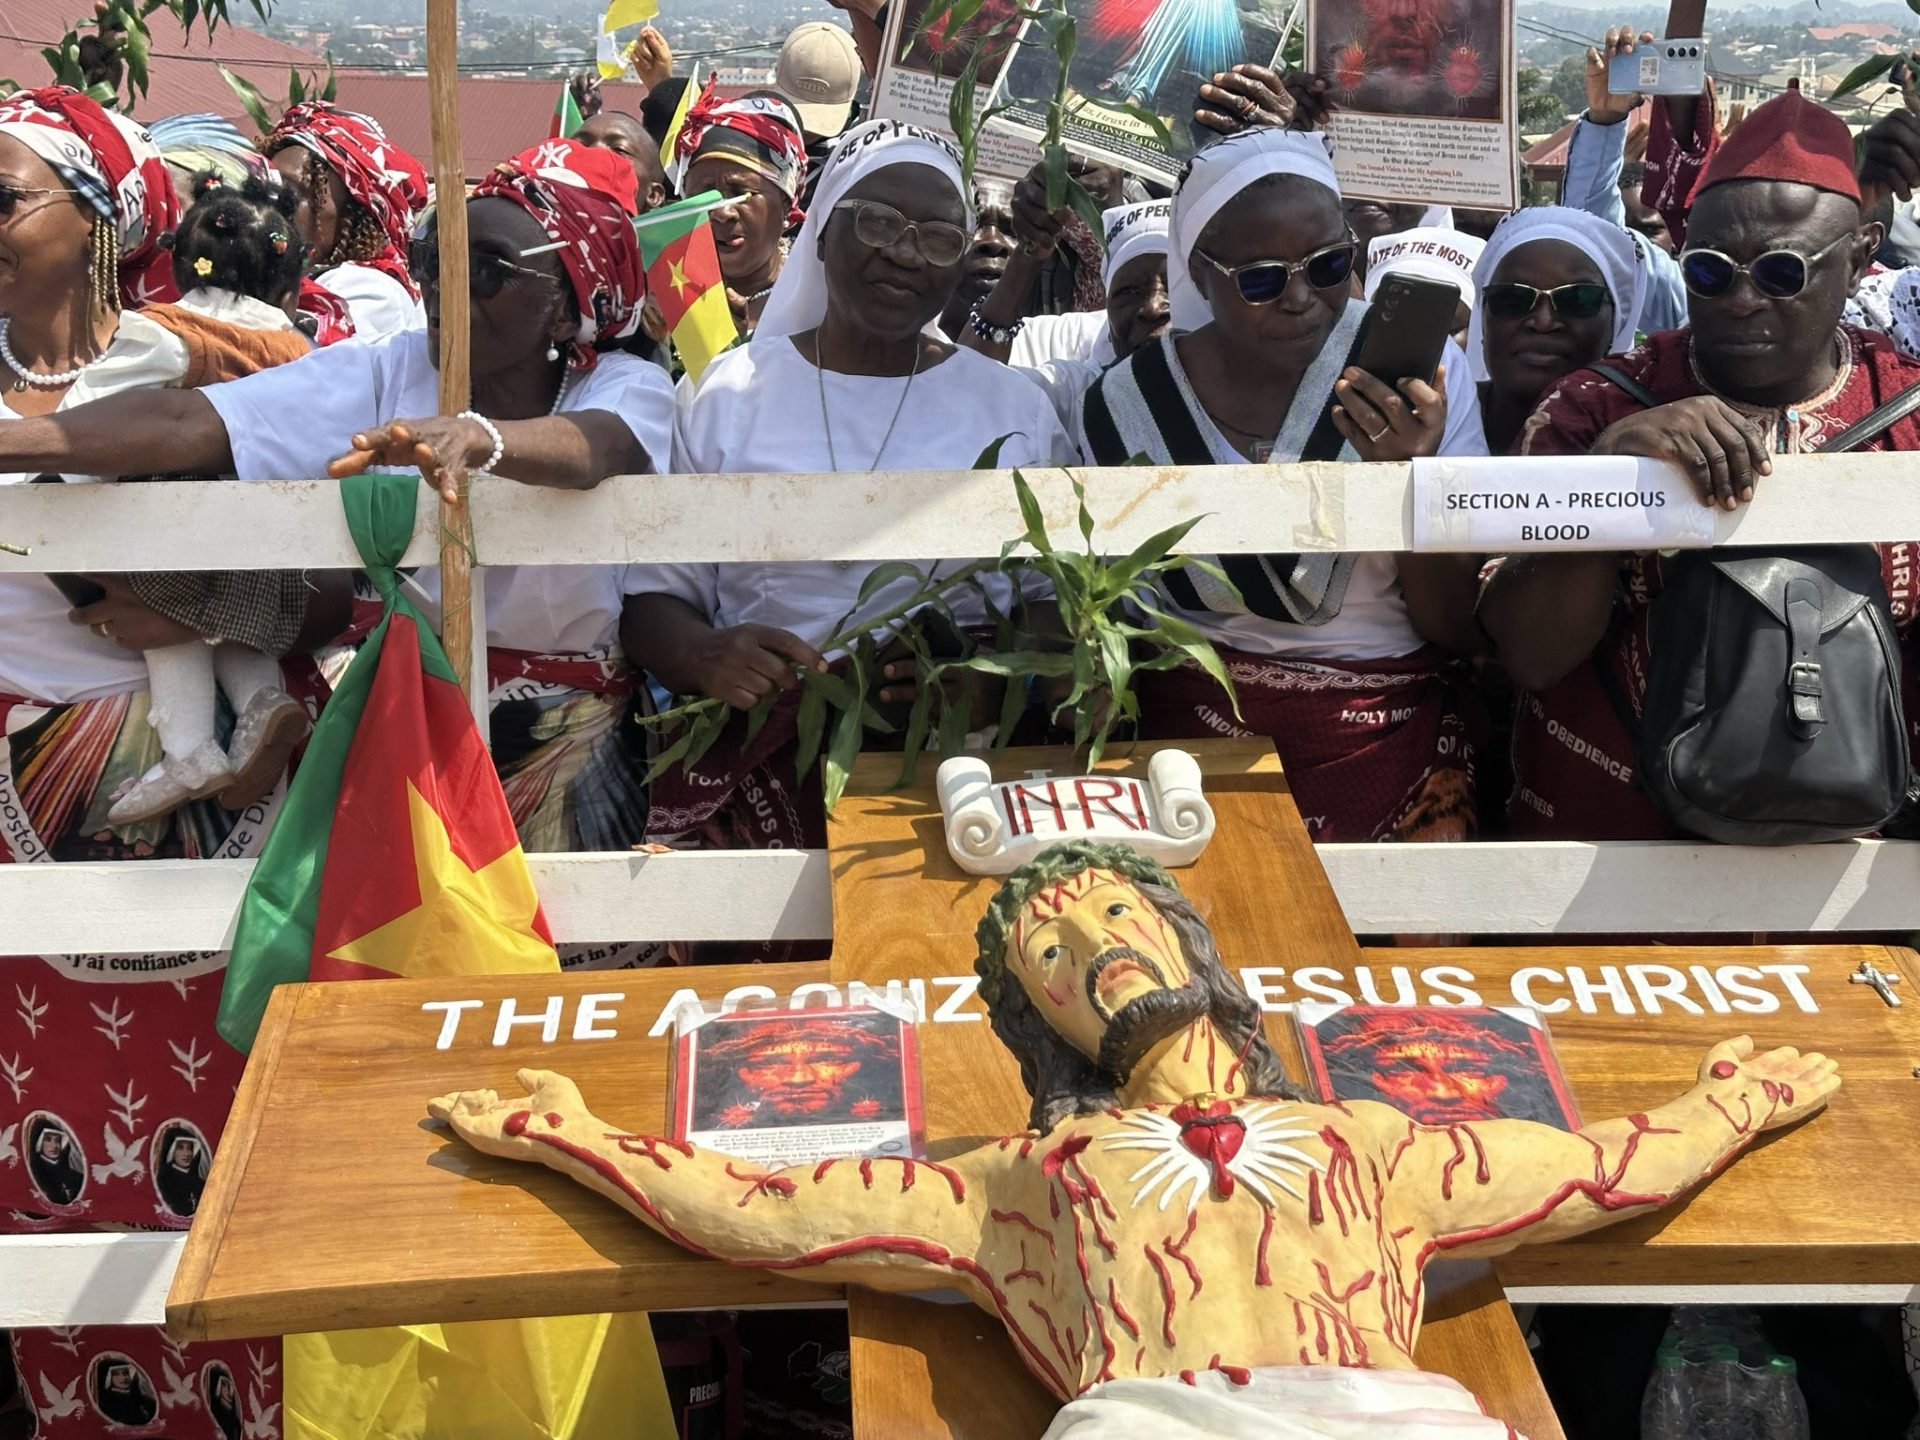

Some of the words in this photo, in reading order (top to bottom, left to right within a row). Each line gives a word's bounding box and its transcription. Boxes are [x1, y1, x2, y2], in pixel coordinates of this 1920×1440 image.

[1101, 112, 1127, 127] trust
[1129, 118, 1140, 129] in
[1126, 207, 1144, 226] OF
[1145, 204, 1171, 218] PER
[1391, 242, 1408, 257] OF
[1409, 241, 1437, 255] THE
[1436, 244, 1473, 271] MOST
[1446, 493, 1530, 510] SECTION
[1535, 493, 1550, 509] A
[1568, 491, 1666, 509] PRECIOUS
[1521, 525, 1591, 541] BLOOD
[1890, 542, 1911, 618] HRIS
[1341, 709, 1387, 724] HOLY
[1546, 719, 1633, 783] OBEDIENCE
[740, 773, 777, 834] ESUS
[0, 773, 48, 863] Apostol
[109, 950, 198, 971] confiance
[560, 952, 584, 968] ust
[588, 946, 606, 961] in
[422, 992, 625, 1050] THE
[648, 976, 982, 1039] AGONIZ
[1239, 964, 1483, 1012] ESUS
[1510, 963, 1821, 1015] CHRIST
[690, 1381, 720, 1404] PRECIO
